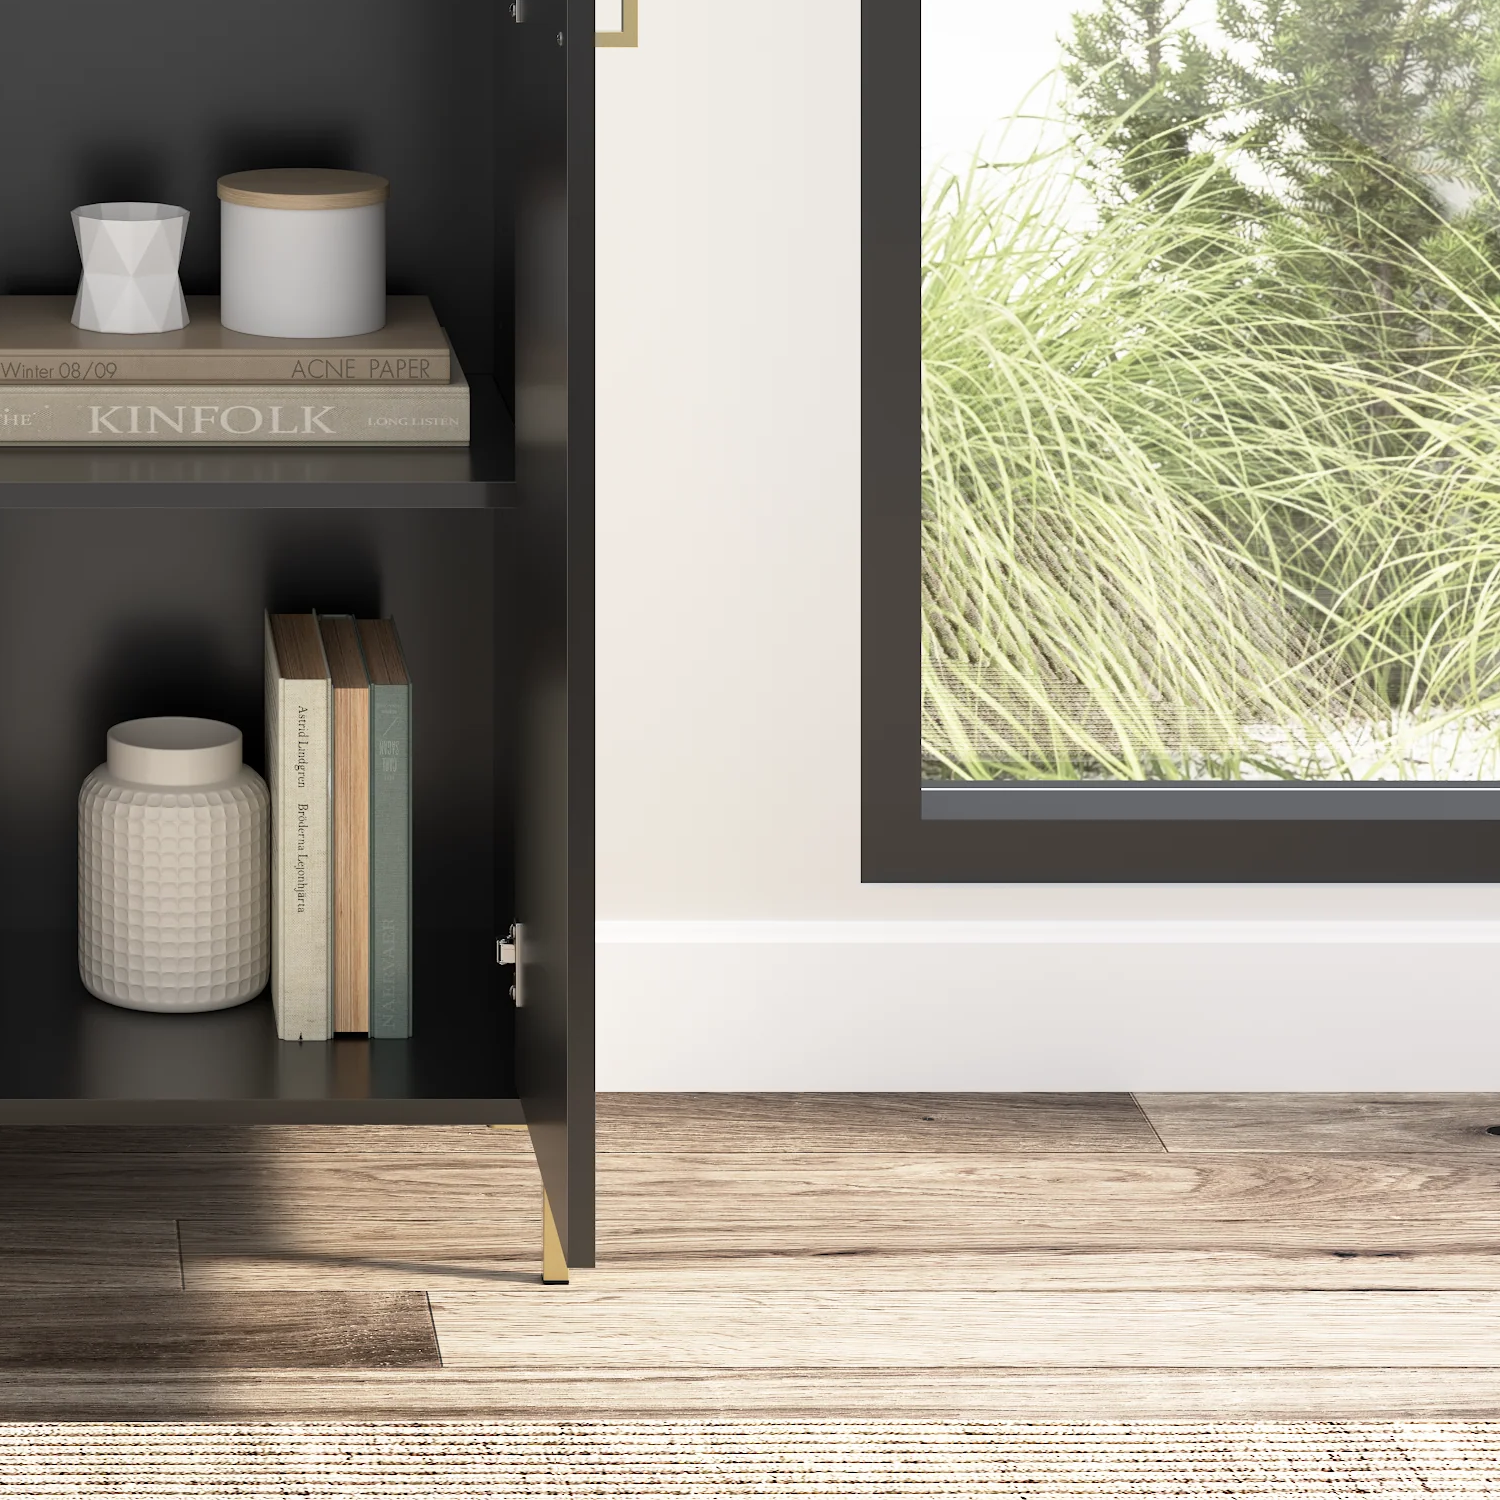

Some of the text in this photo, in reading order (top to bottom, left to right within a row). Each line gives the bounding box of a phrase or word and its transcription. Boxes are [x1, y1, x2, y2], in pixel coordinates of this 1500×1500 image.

[0, 360, 430, 380] Winter 08/09 ACNE PAPER
[88, 406, 336, 434] KINFOLK
[367, 417, 408, 426] LONG
[411, 416, 459, 426] LISTEN
[293, 705, 309, 913] Astrid Lindgren Bröderna Lejonhjärta
[381, 919, 396, 1029] NAERVAER
